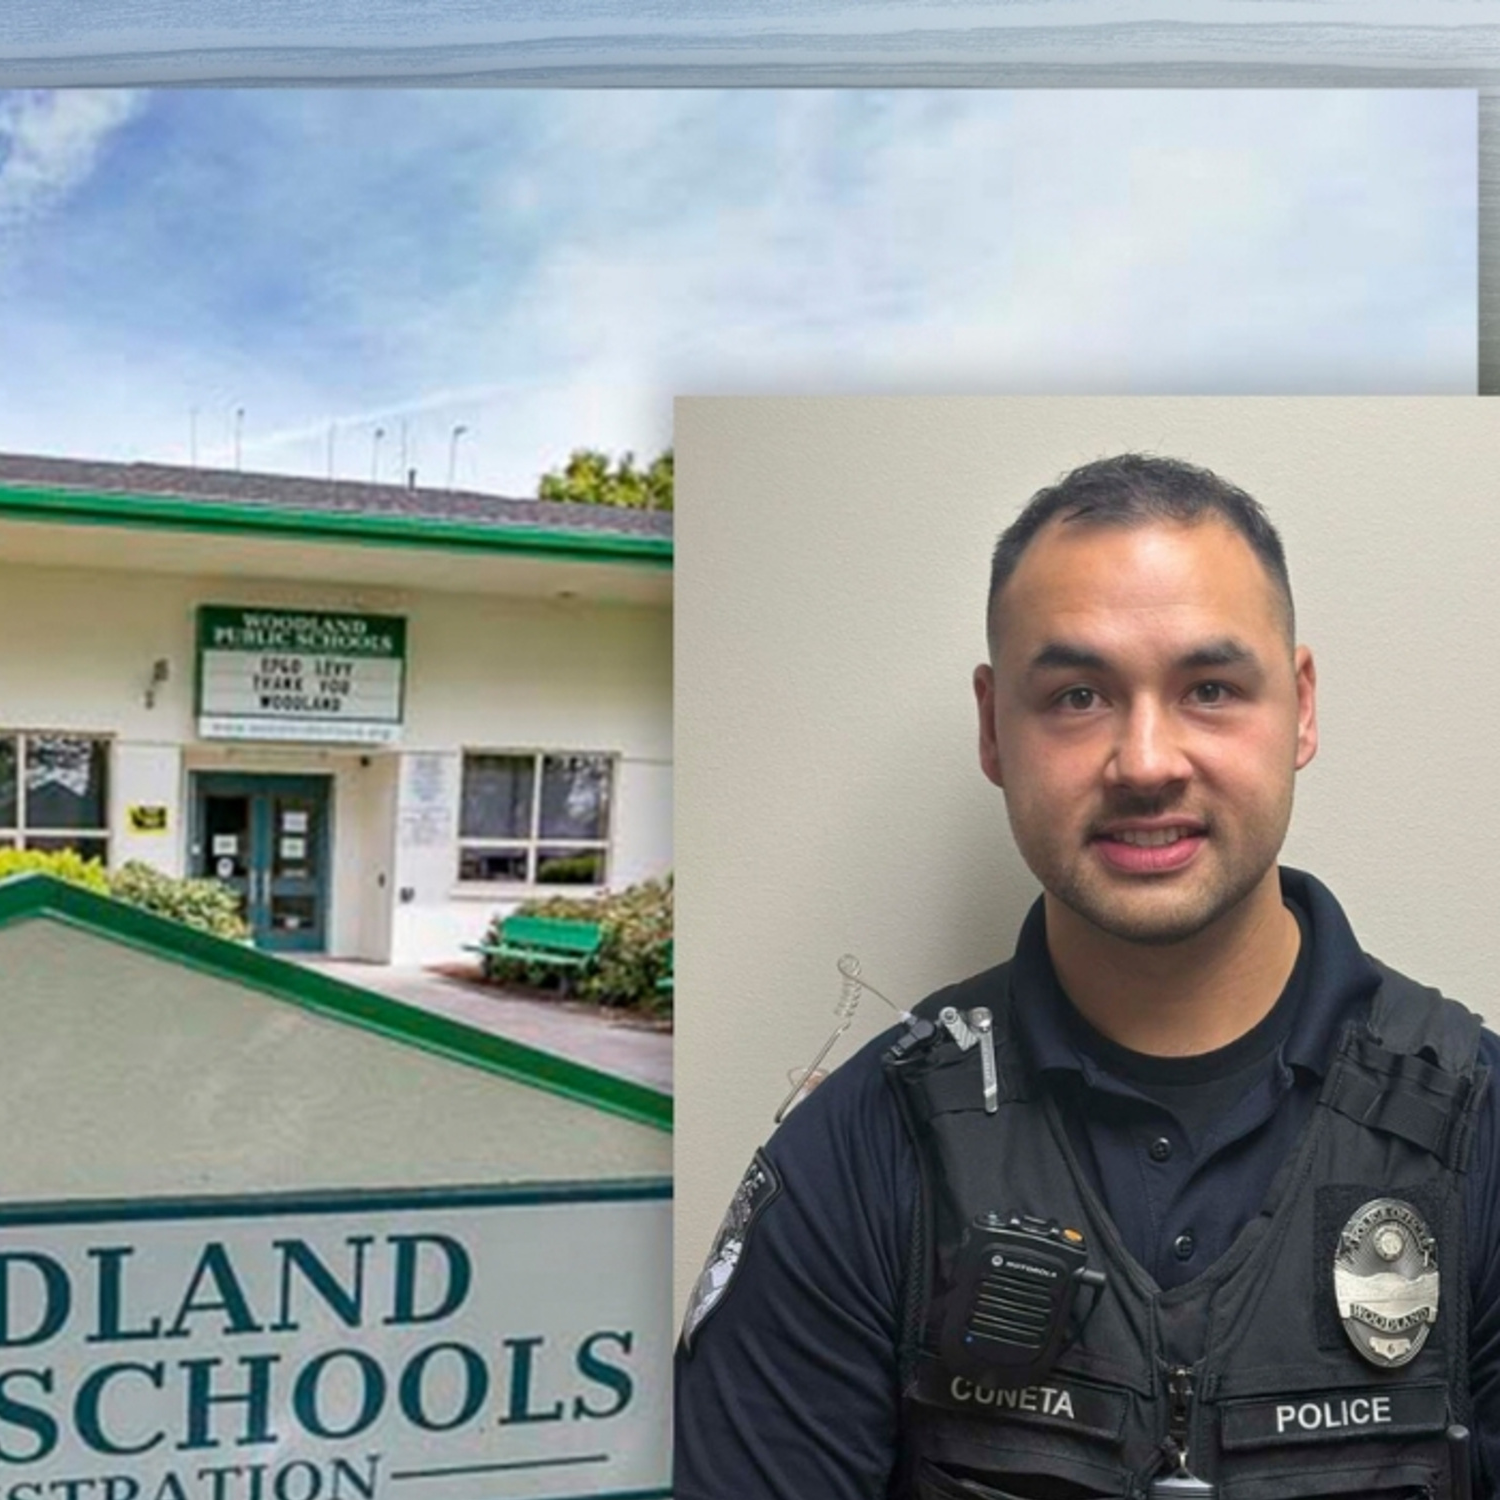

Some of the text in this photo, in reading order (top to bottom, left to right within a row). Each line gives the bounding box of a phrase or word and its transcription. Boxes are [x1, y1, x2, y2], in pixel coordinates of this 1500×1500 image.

[242, 612, 367, 635] WOODLAND
[214, 626, 393, 650] PUBLIC SCHOOLS
[253, 674, 350, 696] THANK YOU
[260, 696, 341, 712] WOODLAND
[1005, 1260, 1058, 1278] MOTOROLA
[1350, 1304, 1430, 1332] WOODLAND
[950, 1375, 1075, 1419] CUNETA
[1276, 1396, 1392, 1433] POLICE
